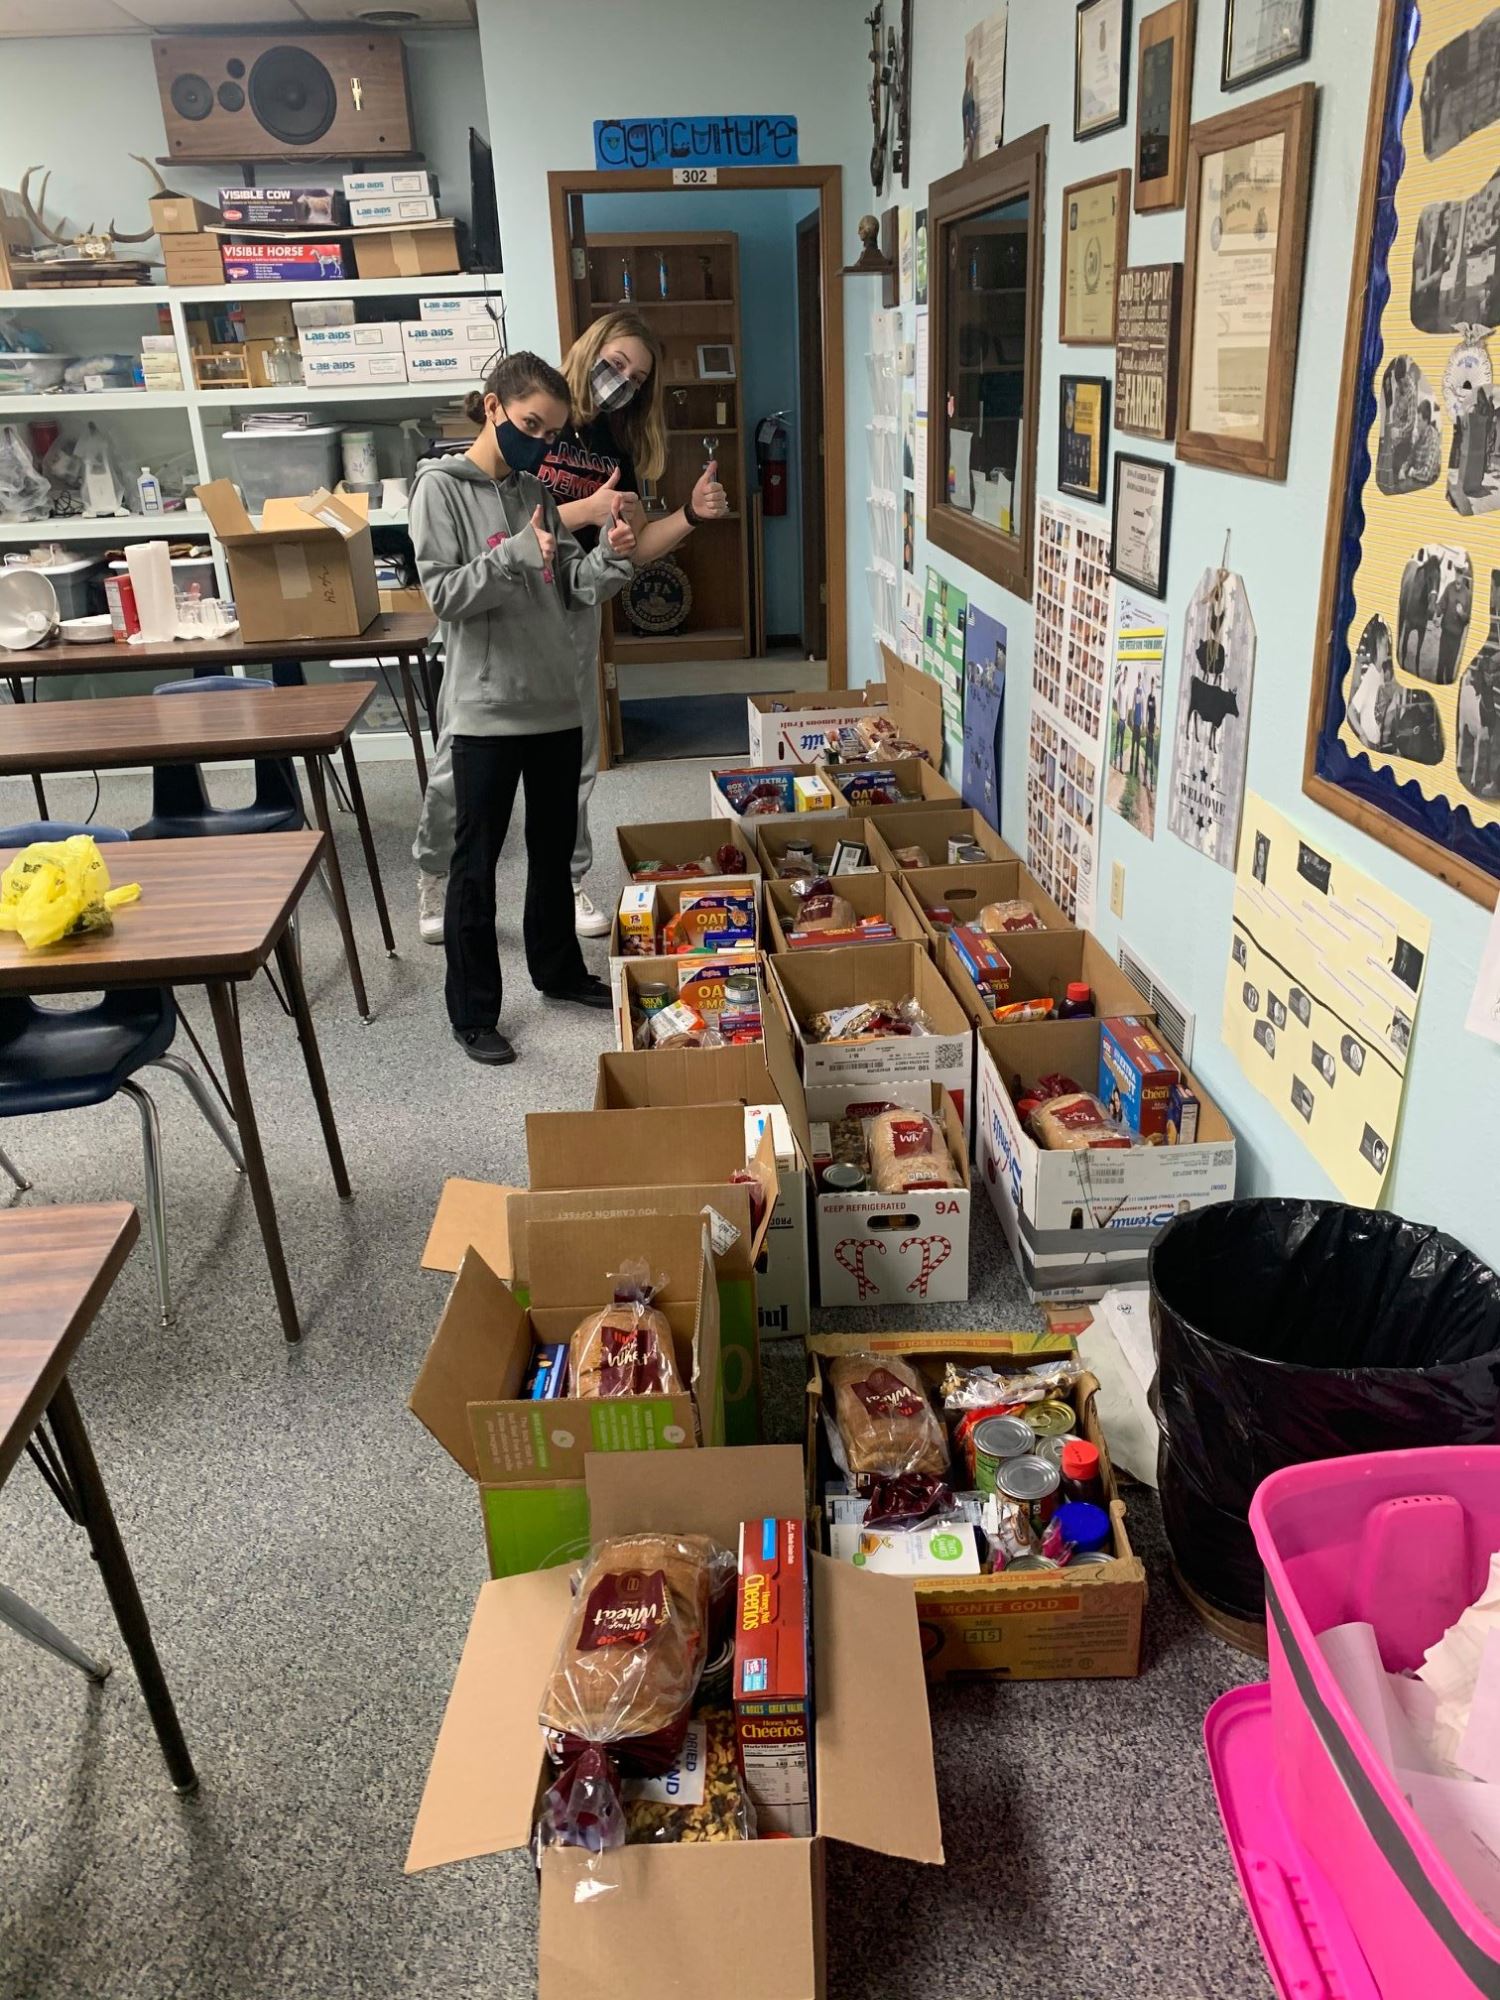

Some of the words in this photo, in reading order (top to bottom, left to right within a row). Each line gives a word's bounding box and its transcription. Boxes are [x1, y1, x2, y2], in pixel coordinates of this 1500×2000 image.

[682, 170, 707, 183] 302
[222, 190, 264, 200] VISIBLE
[267, 190, 291, 200] COW
[223, 247, 264, 256] VISIBLE
[267, 246, 304, 256] HORSE
[1153, 271, 1170, 300] DAY
[1125, 374, 1162, 431] FARMER
[537, 464, 605, 500] DEMO
[644, 582, 672, 594] FFA
[780, 720, 803, 729] Fruit
[806, 718, 842, 728] Famous
[843, 716, 861, 725] rld
[759, 777, 788, 785] EXTRA
[851, 789, 874, 800] OAT
[1180, 782, 1226, 817] WELCOME
[697, 913, 727, 925] OAT
[698, 985, 724, 998] OA
[706, 999, 726, 1009] MO
[1142, 1088, 1169, 1100] Cheeri
[638, 1208, 658, 1217] YOU
[824, 1204, 844, 1213] KEEP
[846, 1202, 906, 1212] REFRIGERATED
[935, 1200, 960, 1214] 9A
[558, 1209, 592, 1219] OFFSET
[595, 1209, 636, 1219] CARBON
[1110, 1212, 1176, 1229] Stemilt
[743, 1573, 764, 1631] Cheerios
[761, 1591, 770, 1611] Honey
[940, 1602, 1003, 1615] MONTE
[1010, 1599, 1059, 1612] GOLD
[593, 1603, 657, 1626] Wheat
[761, 1611, 770, 1625] Nut
[607, 1620, 642, 1630] Cottage
[768, 1703, 786, 1713] GREAT
[787, 1703, 804, 1712] VALUE
[742, 1724, 805, 1738] Cheerios
[686, 1733, 698, 1772] DRIED
[666, 1768, 680, 1795] ND
